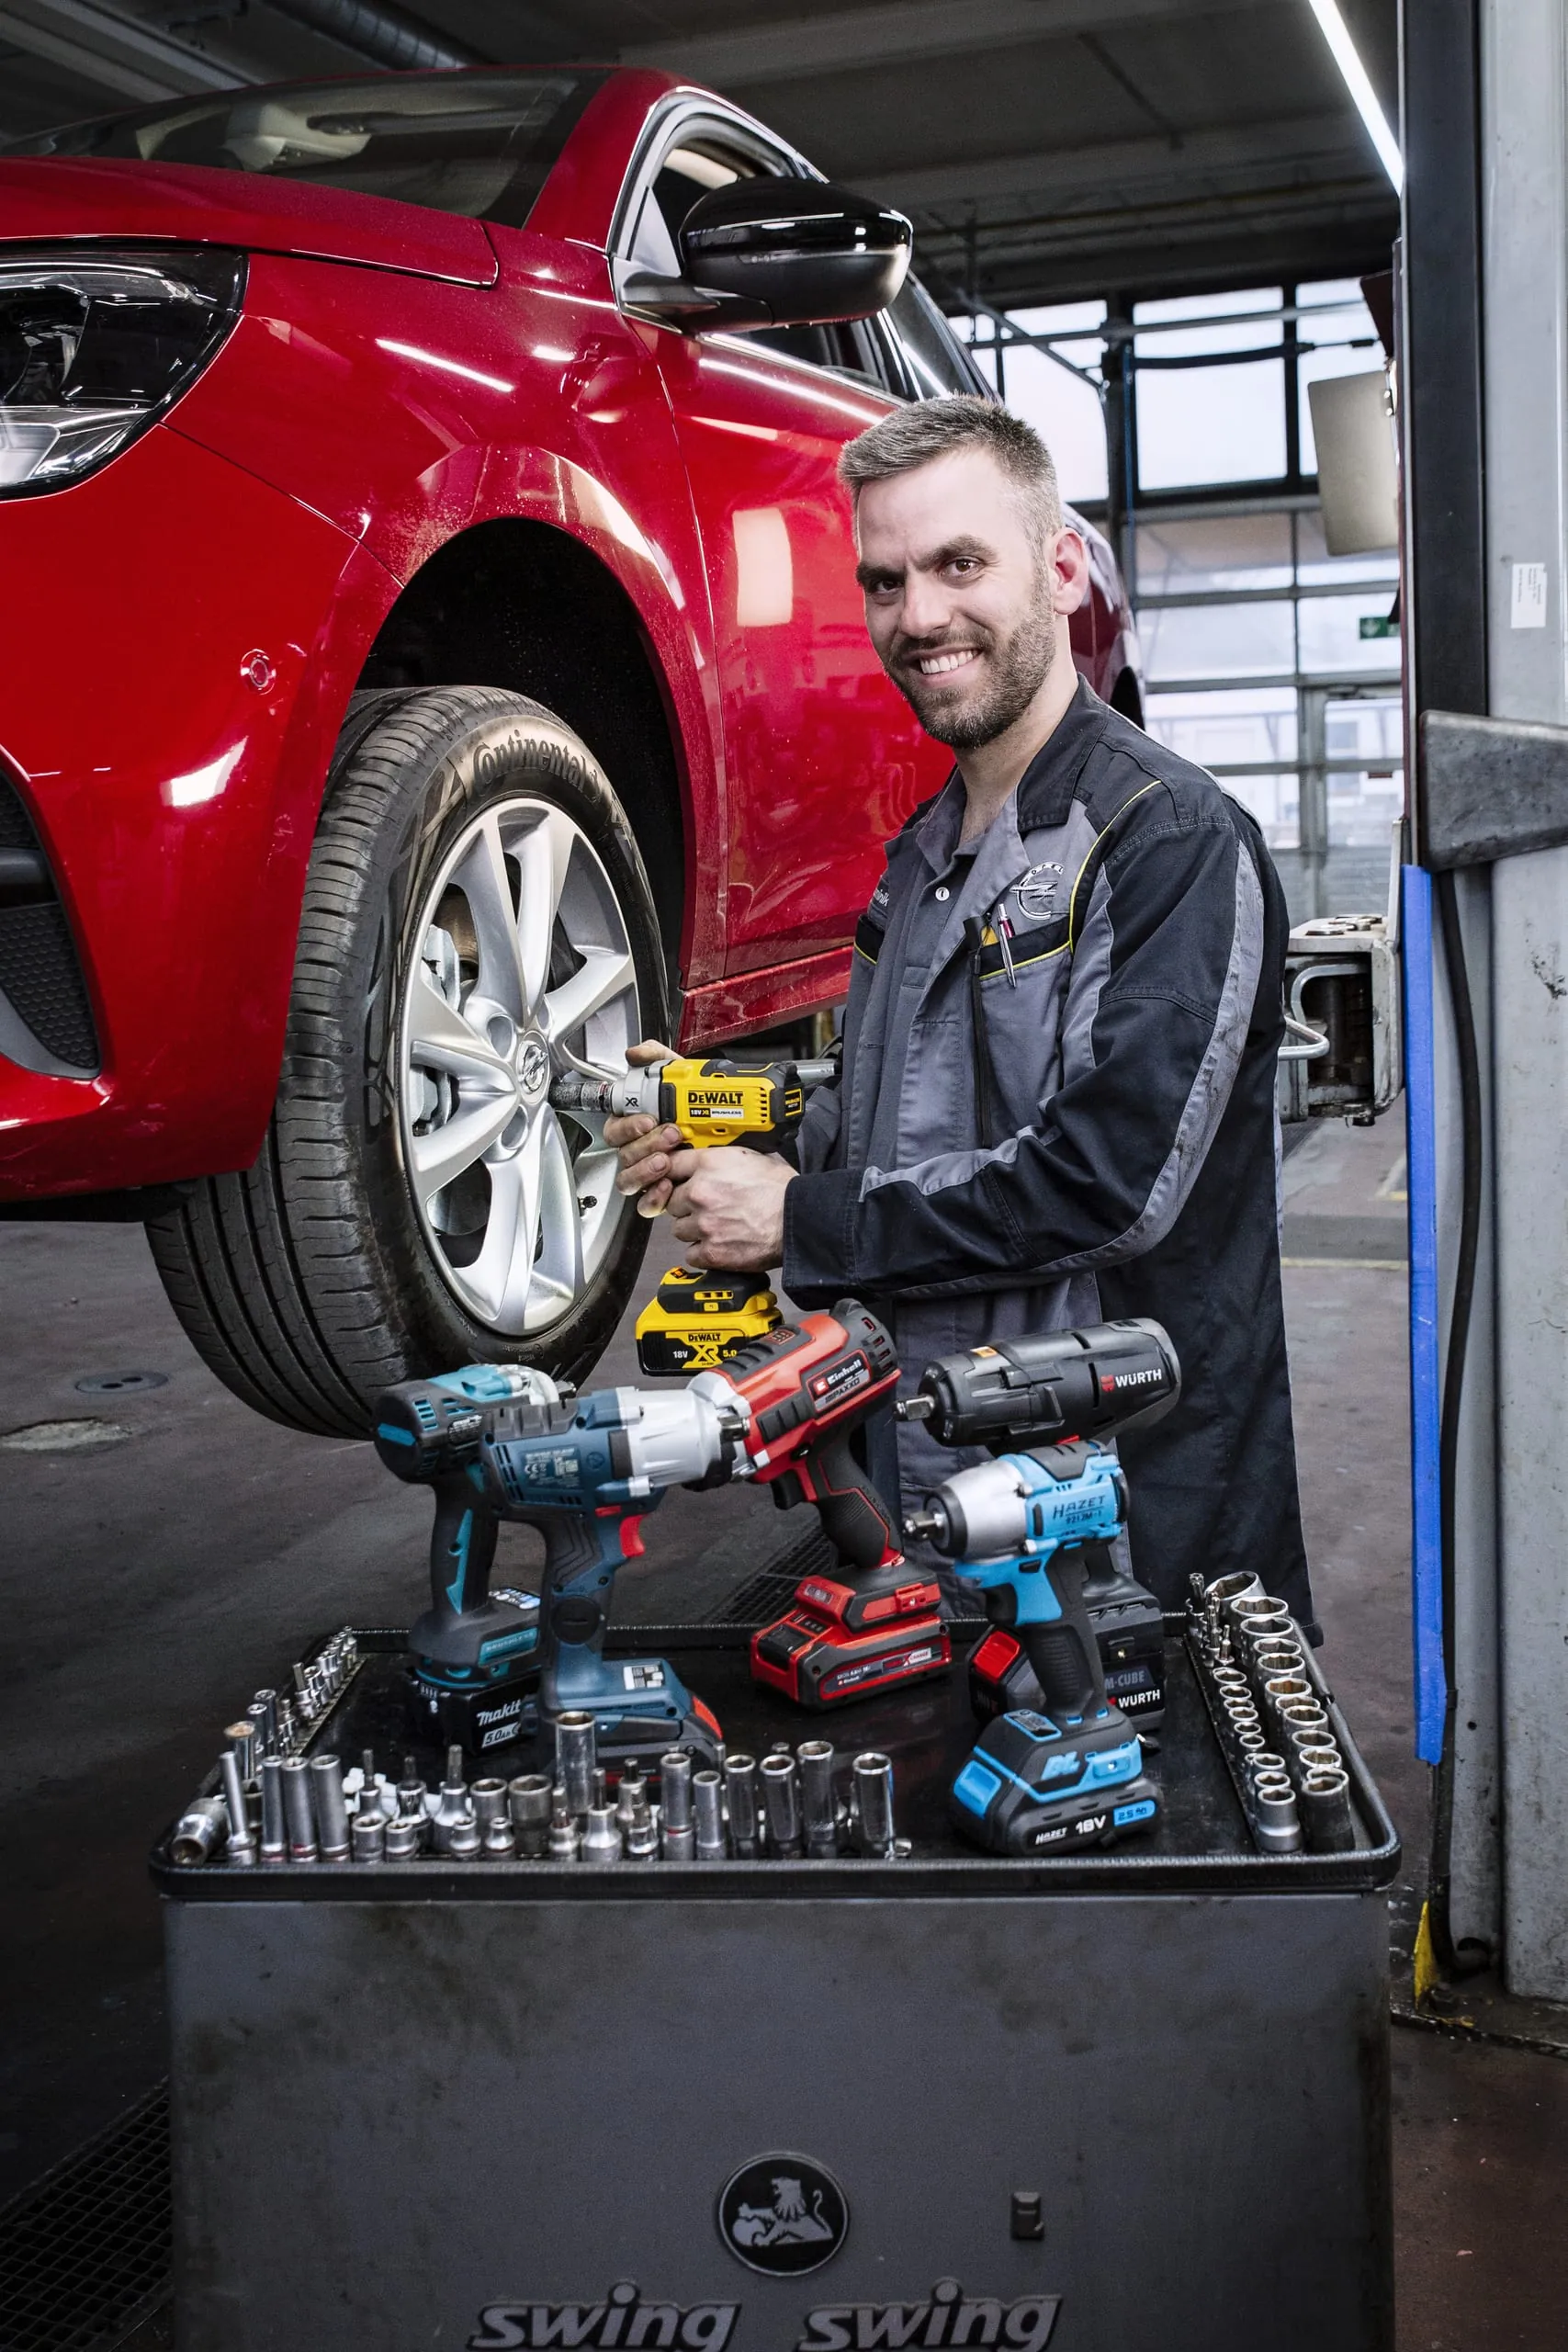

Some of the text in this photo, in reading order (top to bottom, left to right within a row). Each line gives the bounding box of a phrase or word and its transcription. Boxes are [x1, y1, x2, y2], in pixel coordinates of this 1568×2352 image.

[472, 729, 586, 793] Continental
[672, 1351, 688, 1359] 18V
[827, 1359, 862, 1385] Einhell
[1053, 1496, 1105, 1521] HAZET
[1076, 1815, 1106, 1835] 18V
[471, 2283, 1062, 2352] swing swing
